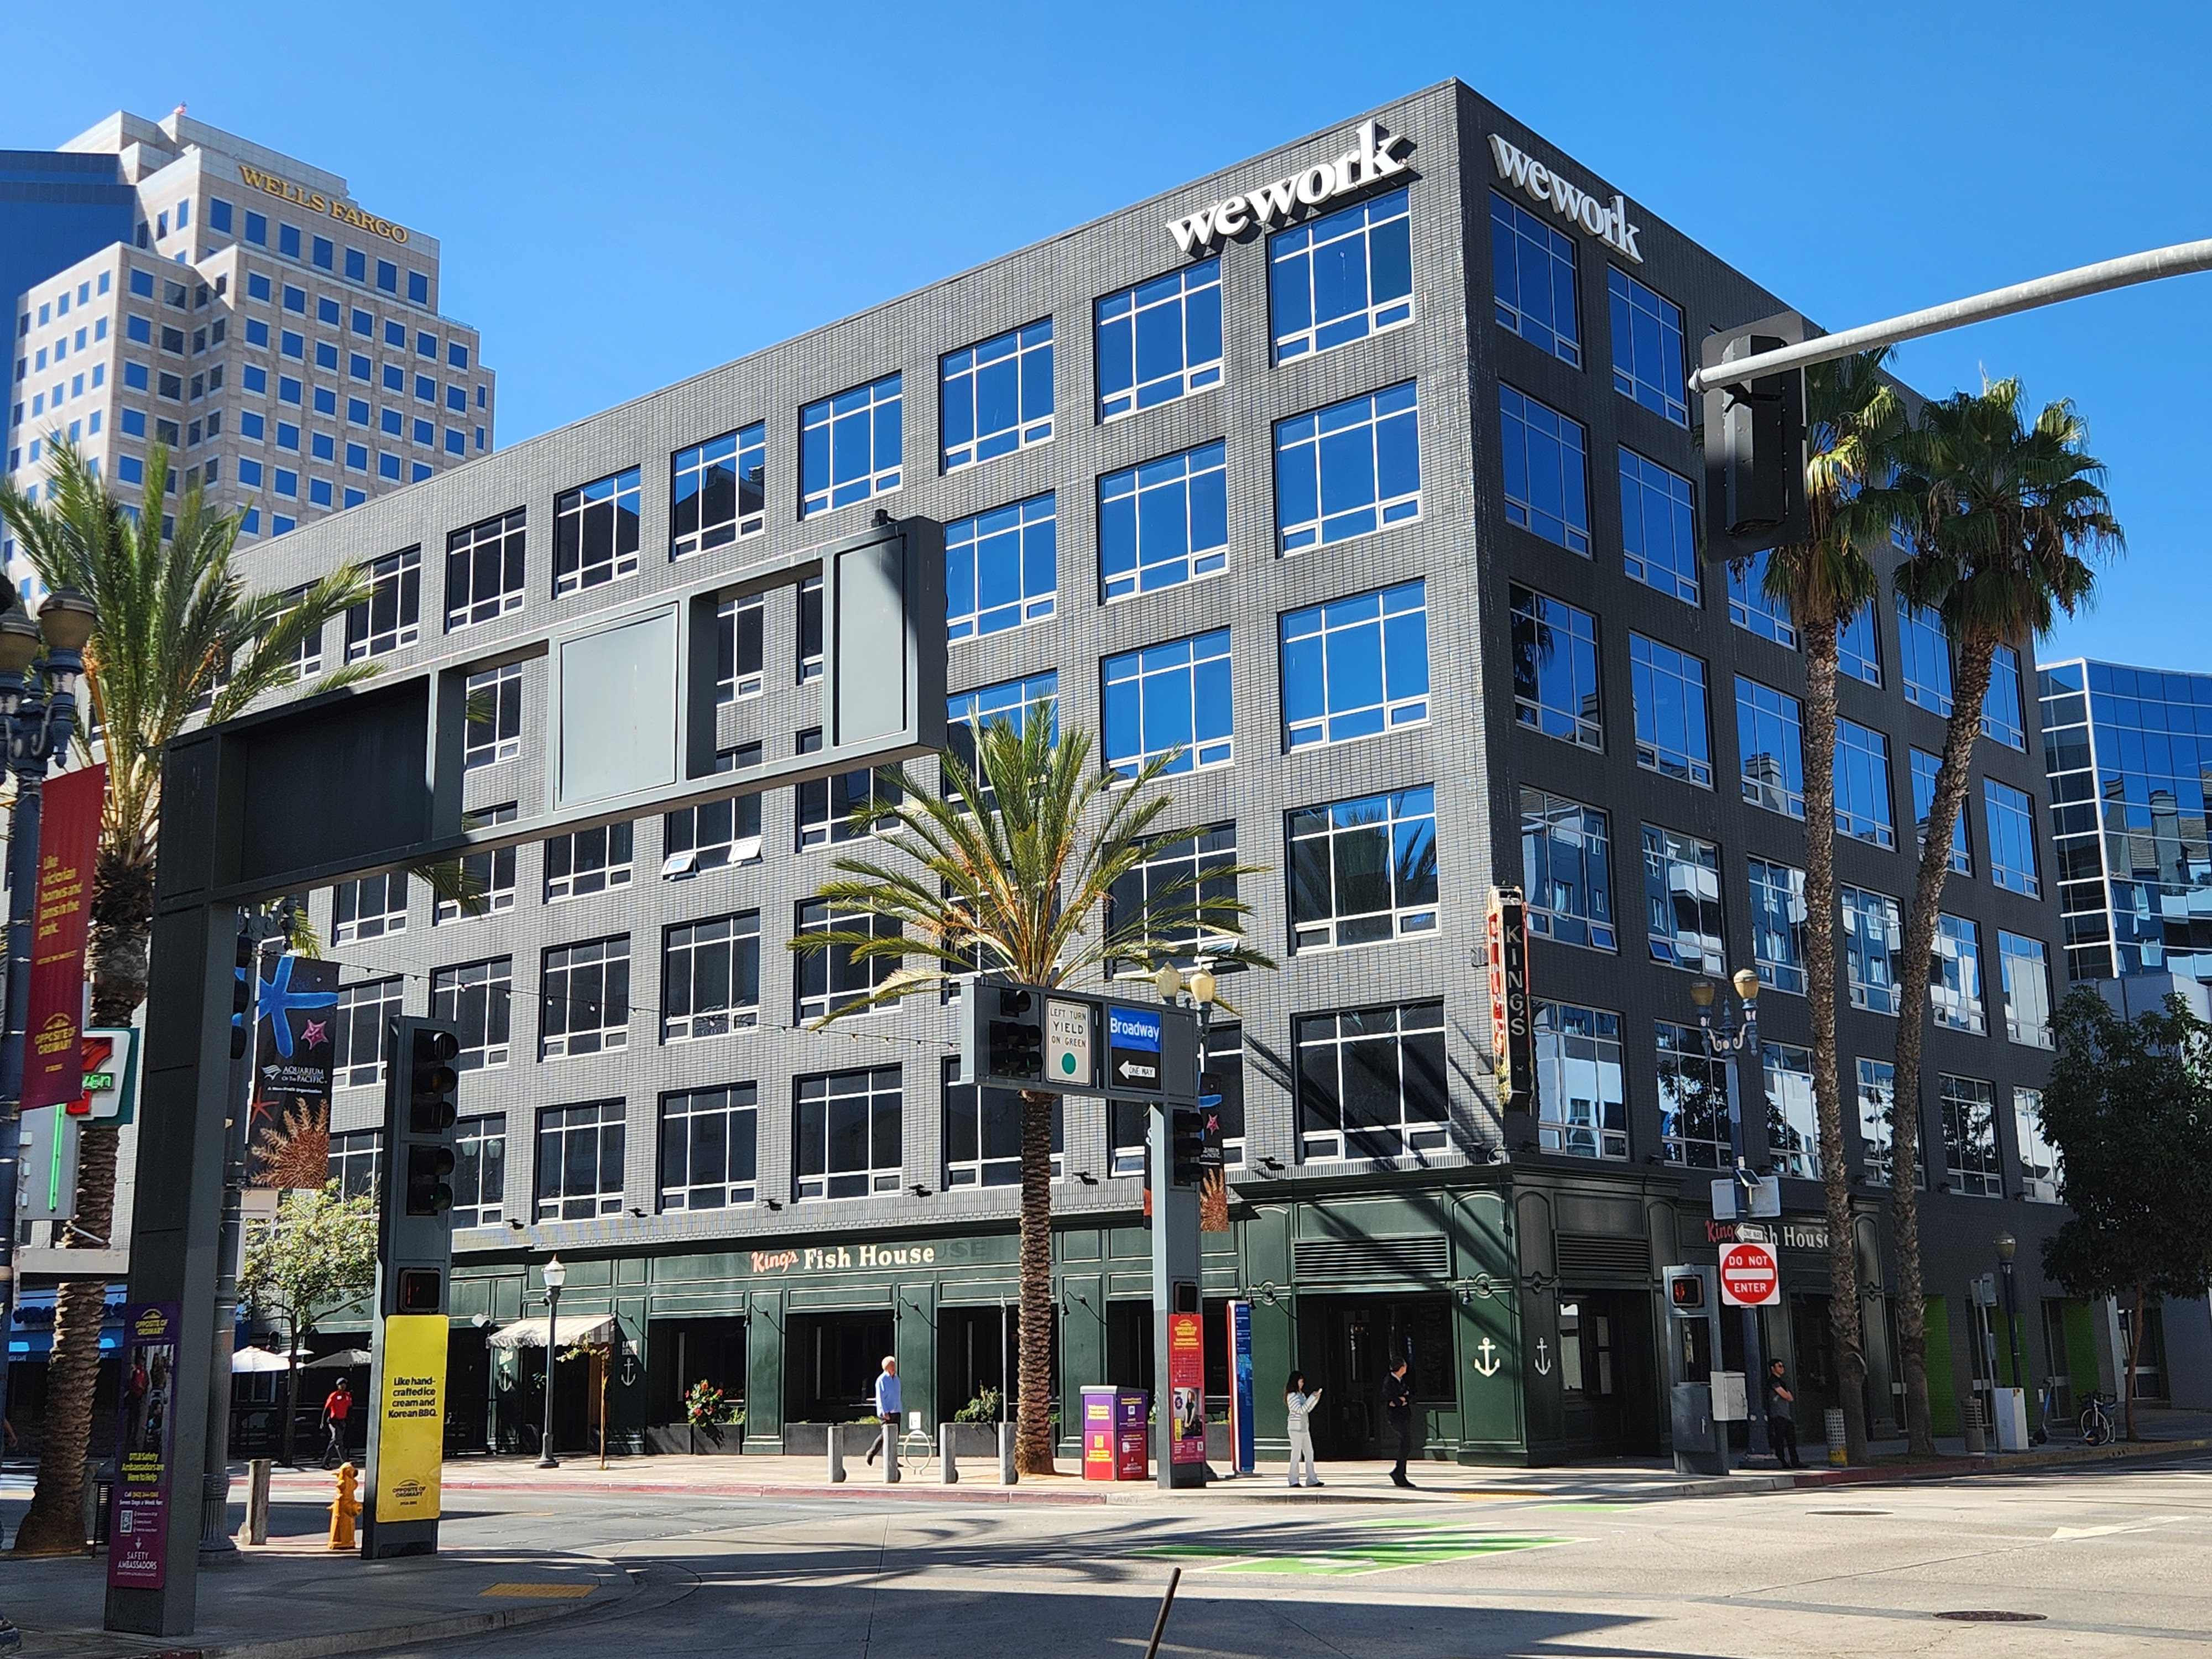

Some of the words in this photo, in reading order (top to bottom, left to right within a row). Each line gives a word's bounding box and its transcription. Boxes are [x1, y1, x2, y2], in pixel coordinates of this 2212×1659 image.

[1166, 118, 1408, 253] wework
[239, 165, 326, 213] WELLS
[330, 200, 409, 244] FARGO
[1487, 133, 1644, 264] wework
[43, 855, 59, 870] Like
[42, 867, 76, 886] victorian
[41, 886, 67, 904] homes
[67, 880, 82, 895] and
[39, 906, 60, 923] jams
[67, 900, 80, 912] the
[39, 920, 60, 940] park.
[1506, 925, 1526, 1036] KING'S
[1051, 1008, 1066, 1018] LEFT
[1070, 1010, 1086, 1021] TURN
[1053, 1021, 1083, 1035] YIELD
[1110, 1017, 1160, 1042] Broadway
[35, 1029, 67, 1045] OPPOSITE
[1052, 1035, 1061, 1044] ON
[1065, 1036, 1086, 1048] GREEN
[282, 1066, 324, 1075] AQUARIUM
[1129, 1066, 1139, 1074] ONE
[1142, 1067, 1154, 1076] WAY
[297, 1075, 325, 1084] PACIFIC
[1705, 1219, 1737, 1243] King'
[750, 1250, 800, 1273] King's
[804, 1246, 852, 1270] Fish
[858, 1244, 935, 1267] House
[1729, 1256, 1743, 1266] DO
[1749, 1256, 1768, 1265] NOT
[1734, 1282, 1767, 1293] ENTER
[394, 1377, 410, 1386] Like
[411, 1377, 436, 1385] hand-
[393, 1387, 423, 1397] crafted
[424, 1387, 436, 1396] ice
[419, 1397, 435, 1406] and
[388, 1410, 418, 1418] Korean
[142, 1452, 159, 1463] Safety
[121, 1463, 156, 1471] Ambassadors
[144, 1473, 157, 1483] Help
[127, 1551, 149, 1560] SAFETY
[117, 1561, 157, 1571] AMBASSADORS
